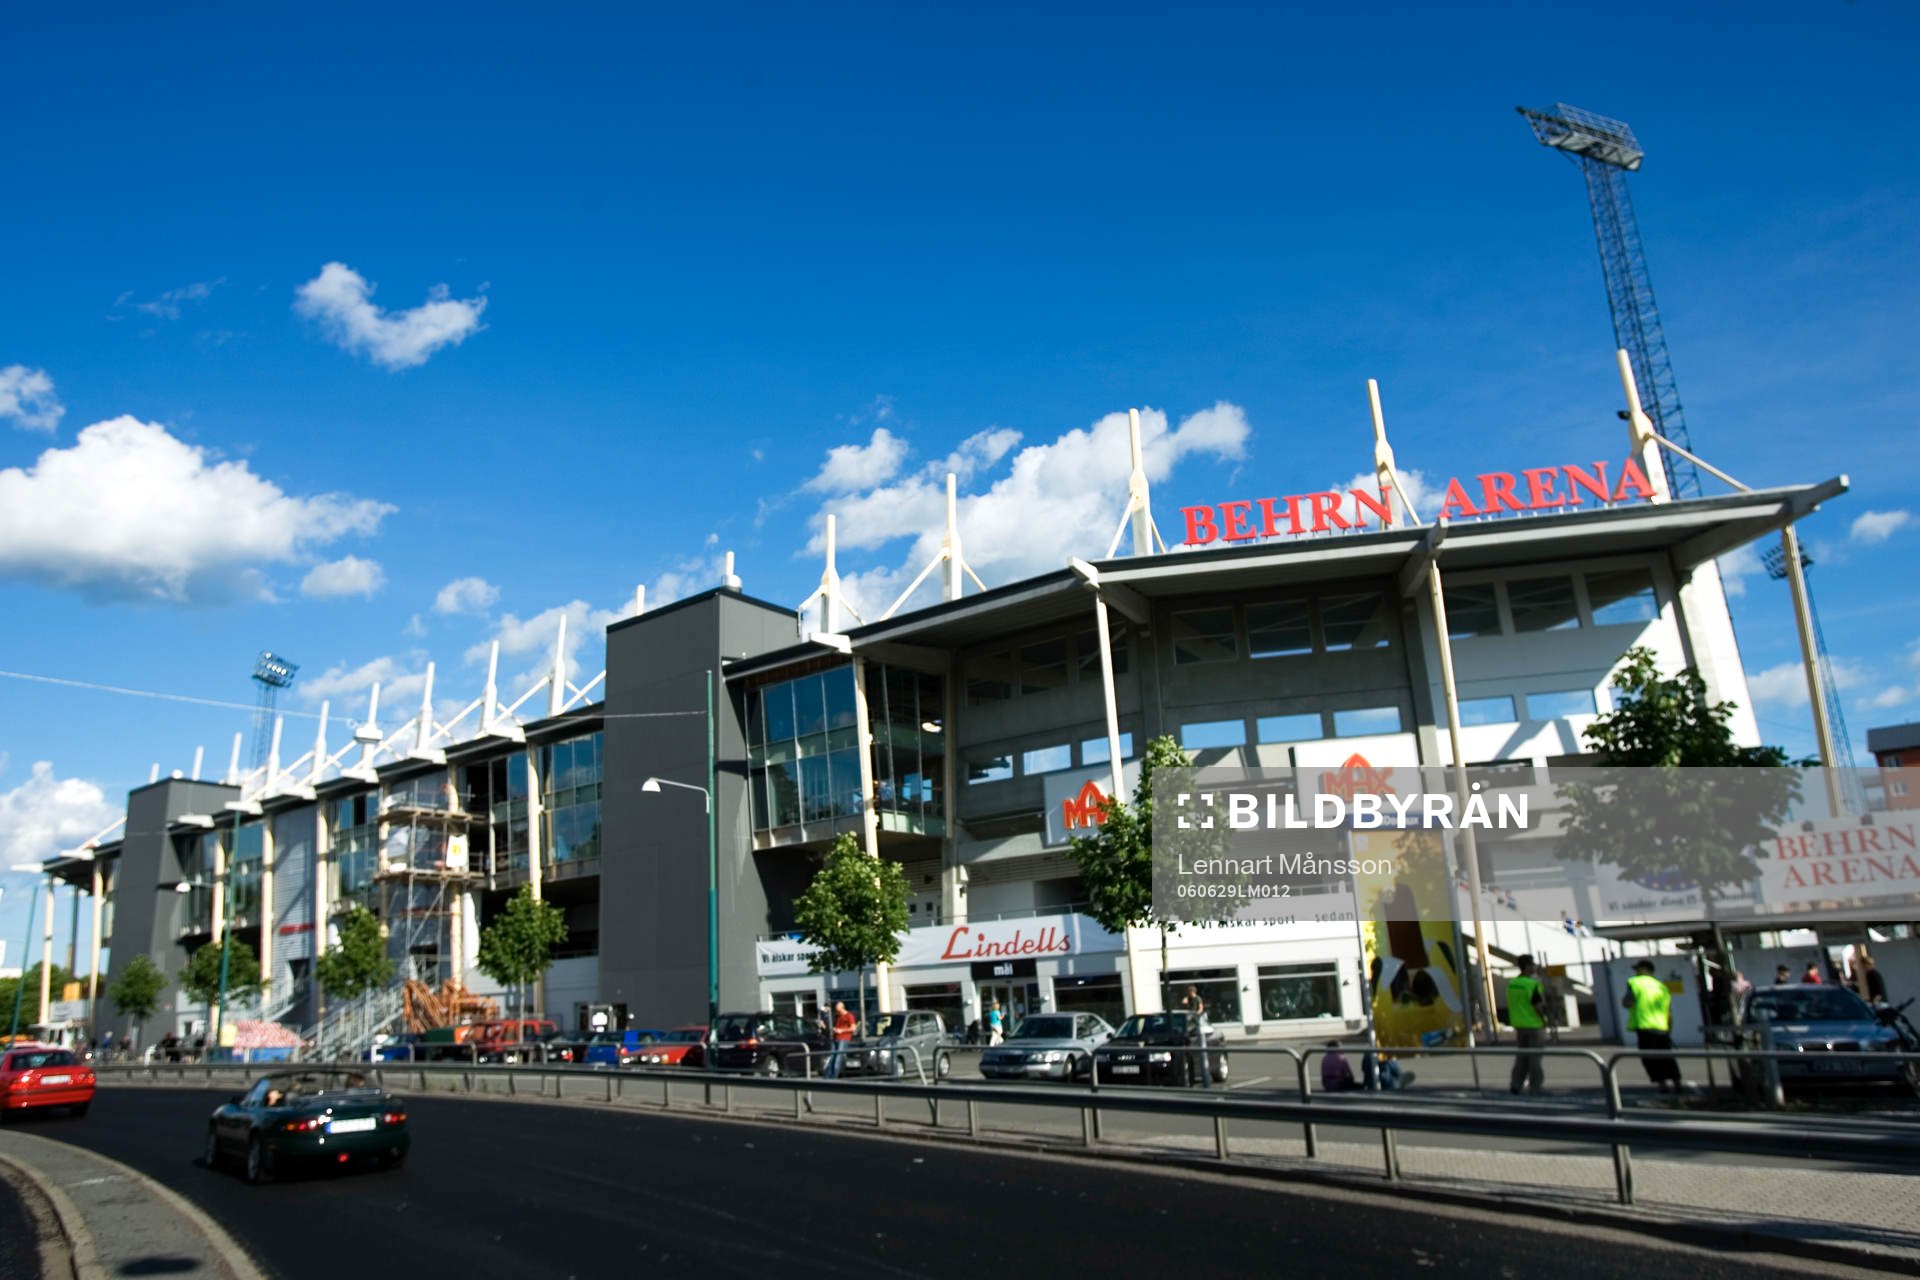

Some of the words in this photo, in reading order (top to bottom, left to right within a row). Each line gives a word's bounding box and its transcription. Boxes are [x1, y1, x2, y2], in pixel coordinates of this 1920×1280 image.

[1180, 485, 1393, 546] BEHRN
[1439, 458, 1657, 519] ARENA
[1321, 752, 1397, 800] MAX
[1775, 824, 1916, 860] BEHRN
[1783, 854, 1920, 888] ARENA
[1262, 914, 1296, 927] sport
[1315, 911, 1354, 923] sedan
[941, 924, 1071, 960] Lindells
